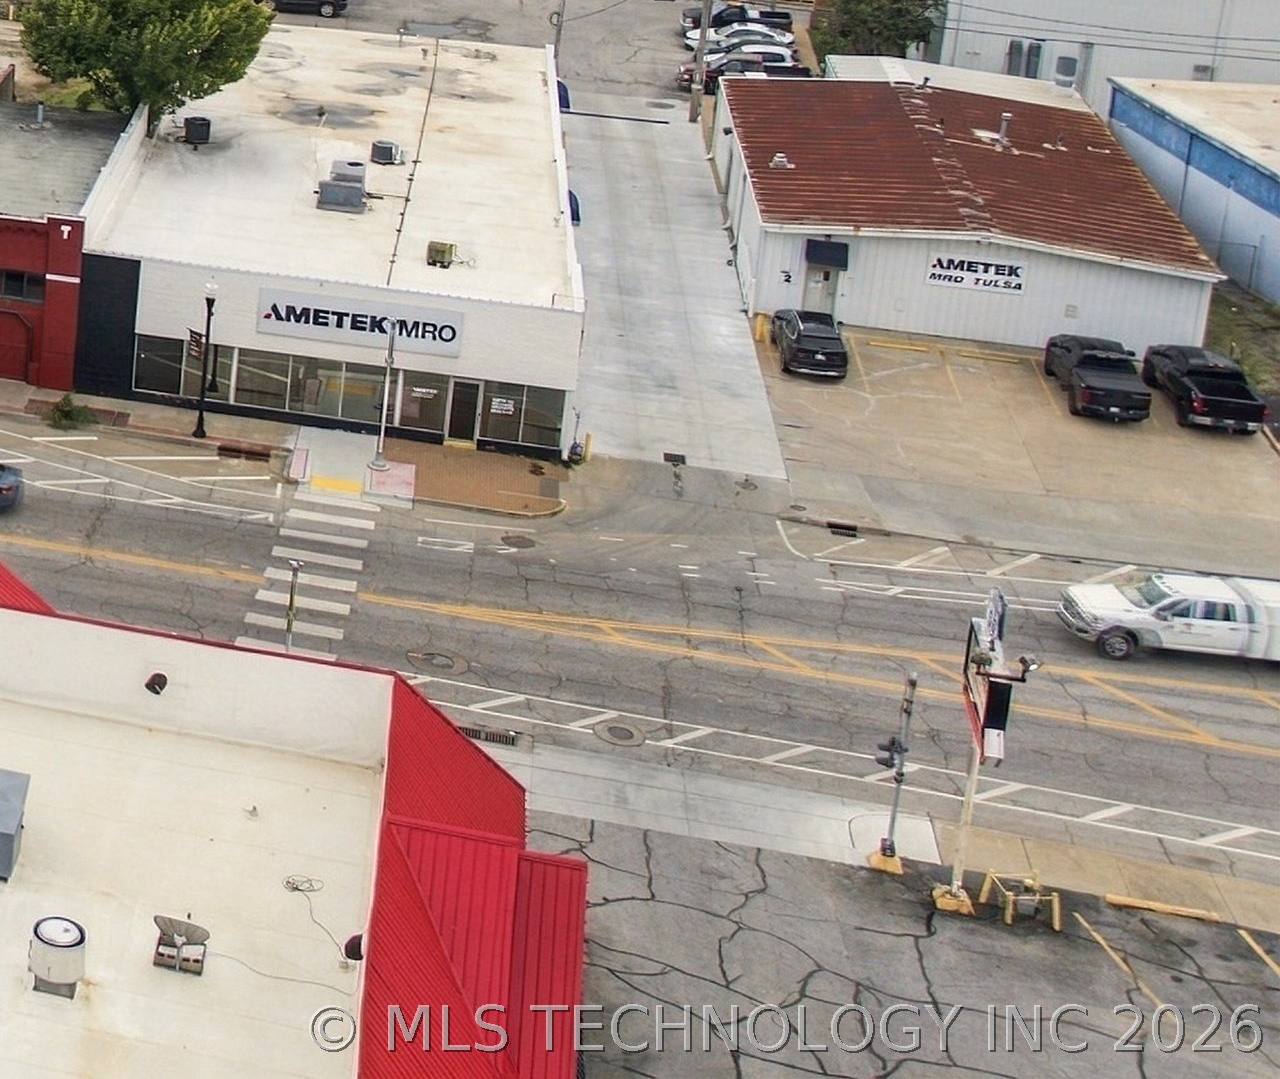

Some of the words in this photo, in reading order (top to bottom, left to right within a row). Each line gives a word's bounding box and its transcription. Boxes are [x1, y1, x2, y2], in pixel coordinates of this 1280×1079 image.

[931, 257, 1023, 278] AMETEK
[928, 272, 965, 284] MRO
[973, 277, 1023, 291] TULSA
[263, 303, 389, 335] AMETEK
[395, 318, 457, 343] MRO
